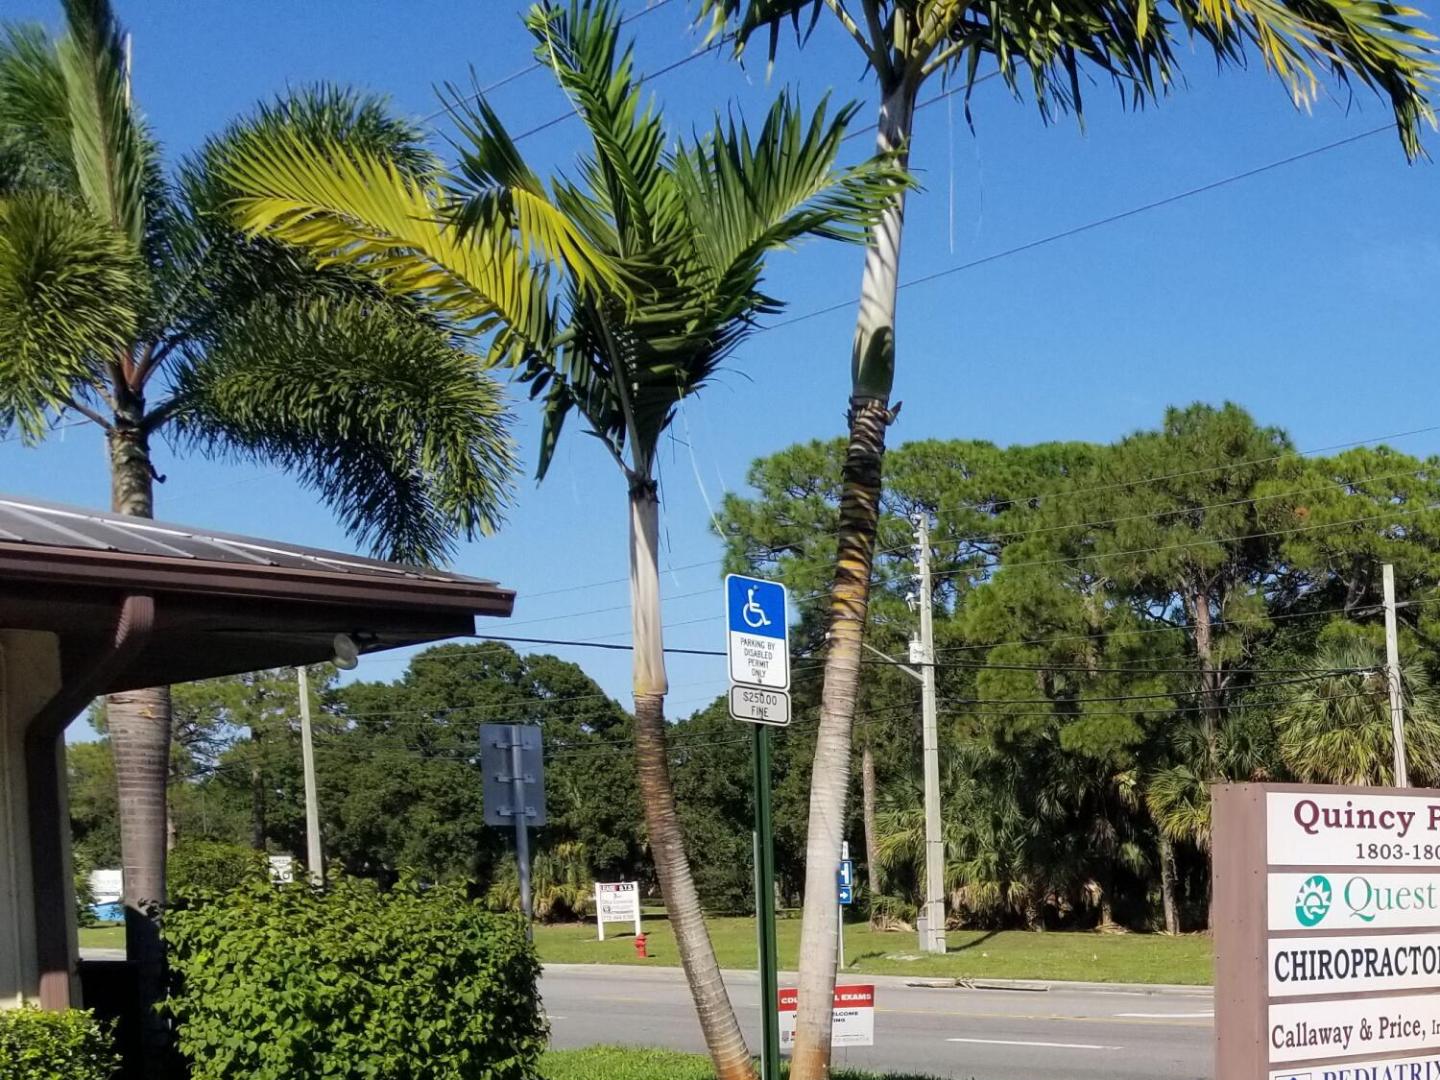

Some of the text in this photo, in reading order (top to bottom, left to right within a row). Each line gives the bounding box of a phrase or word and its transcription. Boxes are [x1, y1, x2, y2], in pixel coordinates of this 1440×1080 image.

[740, 638, 775, 651] PARKING BY
[744, 649, 772, 660] DISABLED
[748, 658, 769, 669] PERMIT
[752, 669, 766, 678] ONLY
[743, 692, 777, 705] $250.00
[751, 706, 768, 717] FINE
[1293, 799, 1416, 838] Quincy
[1343, 876, 1437, 922] Quest
[1271, 1021, 1354, 1050] Callaway
[1359, 1017, 1373, 1041] &
[1378, 1014, 1427, 1042] Price,
